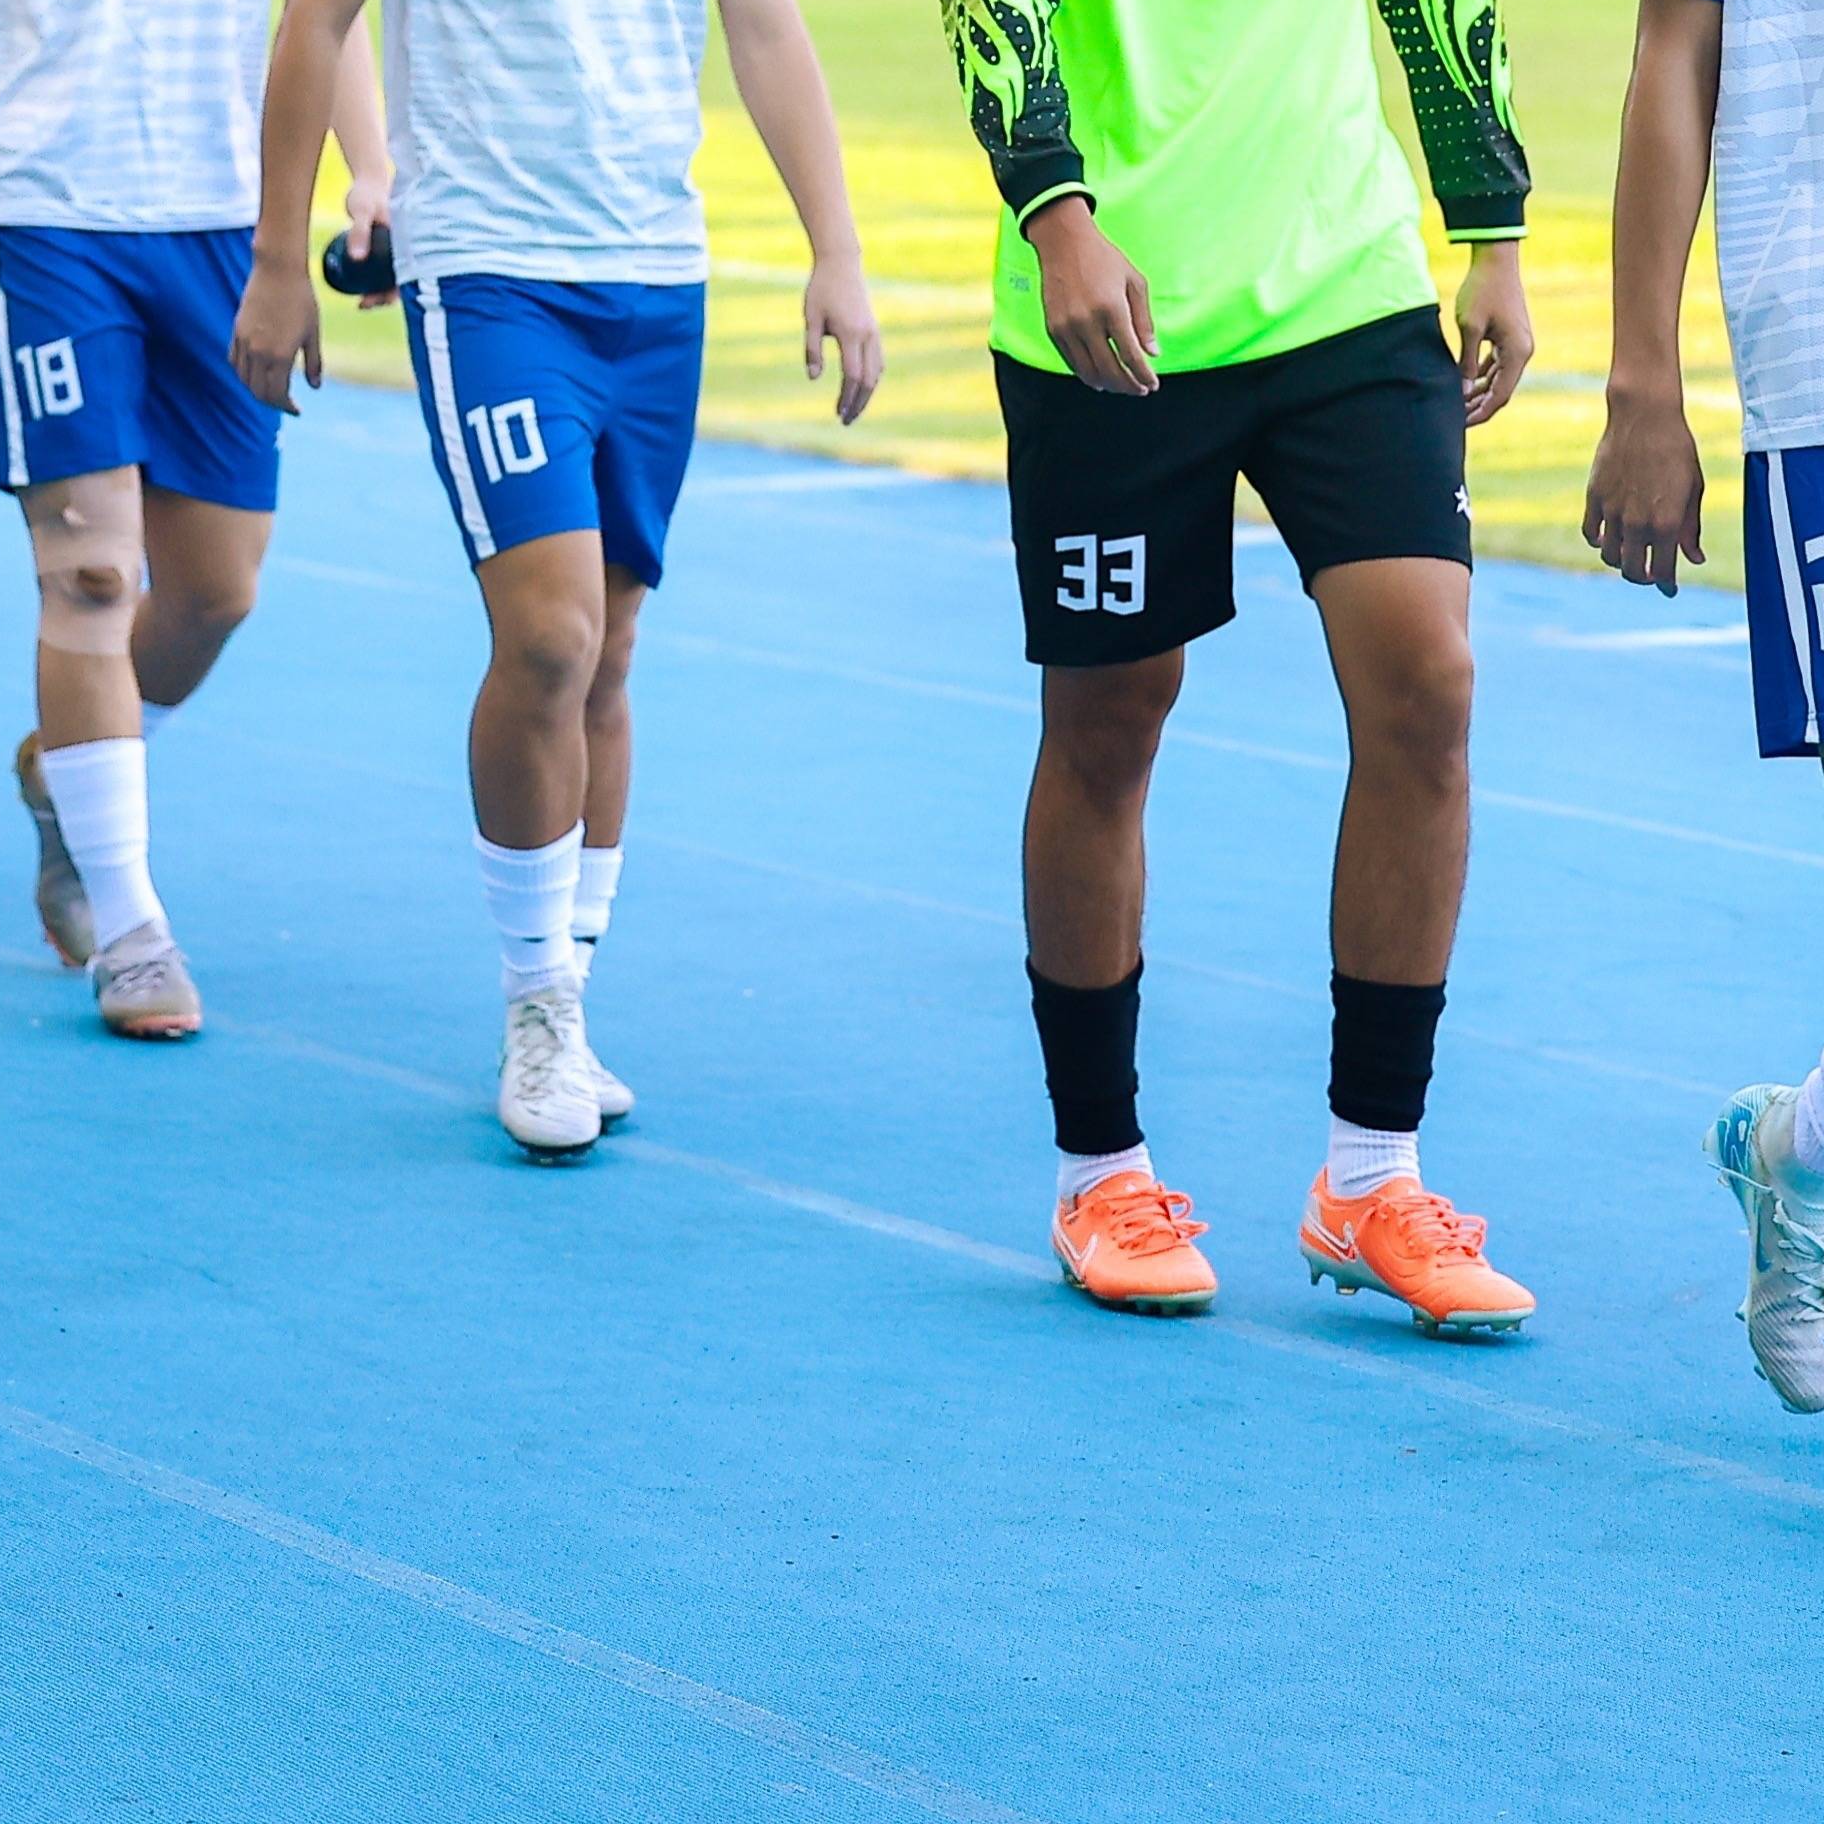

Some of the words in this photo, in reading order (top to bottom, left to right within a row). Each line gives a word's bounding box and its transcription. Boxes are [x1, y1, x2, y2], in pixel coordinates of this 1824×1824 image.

[16, 336, 85, 421] 18
[465, 396, 549, 484] 10
[1054, 533, 1147, 617] 33
